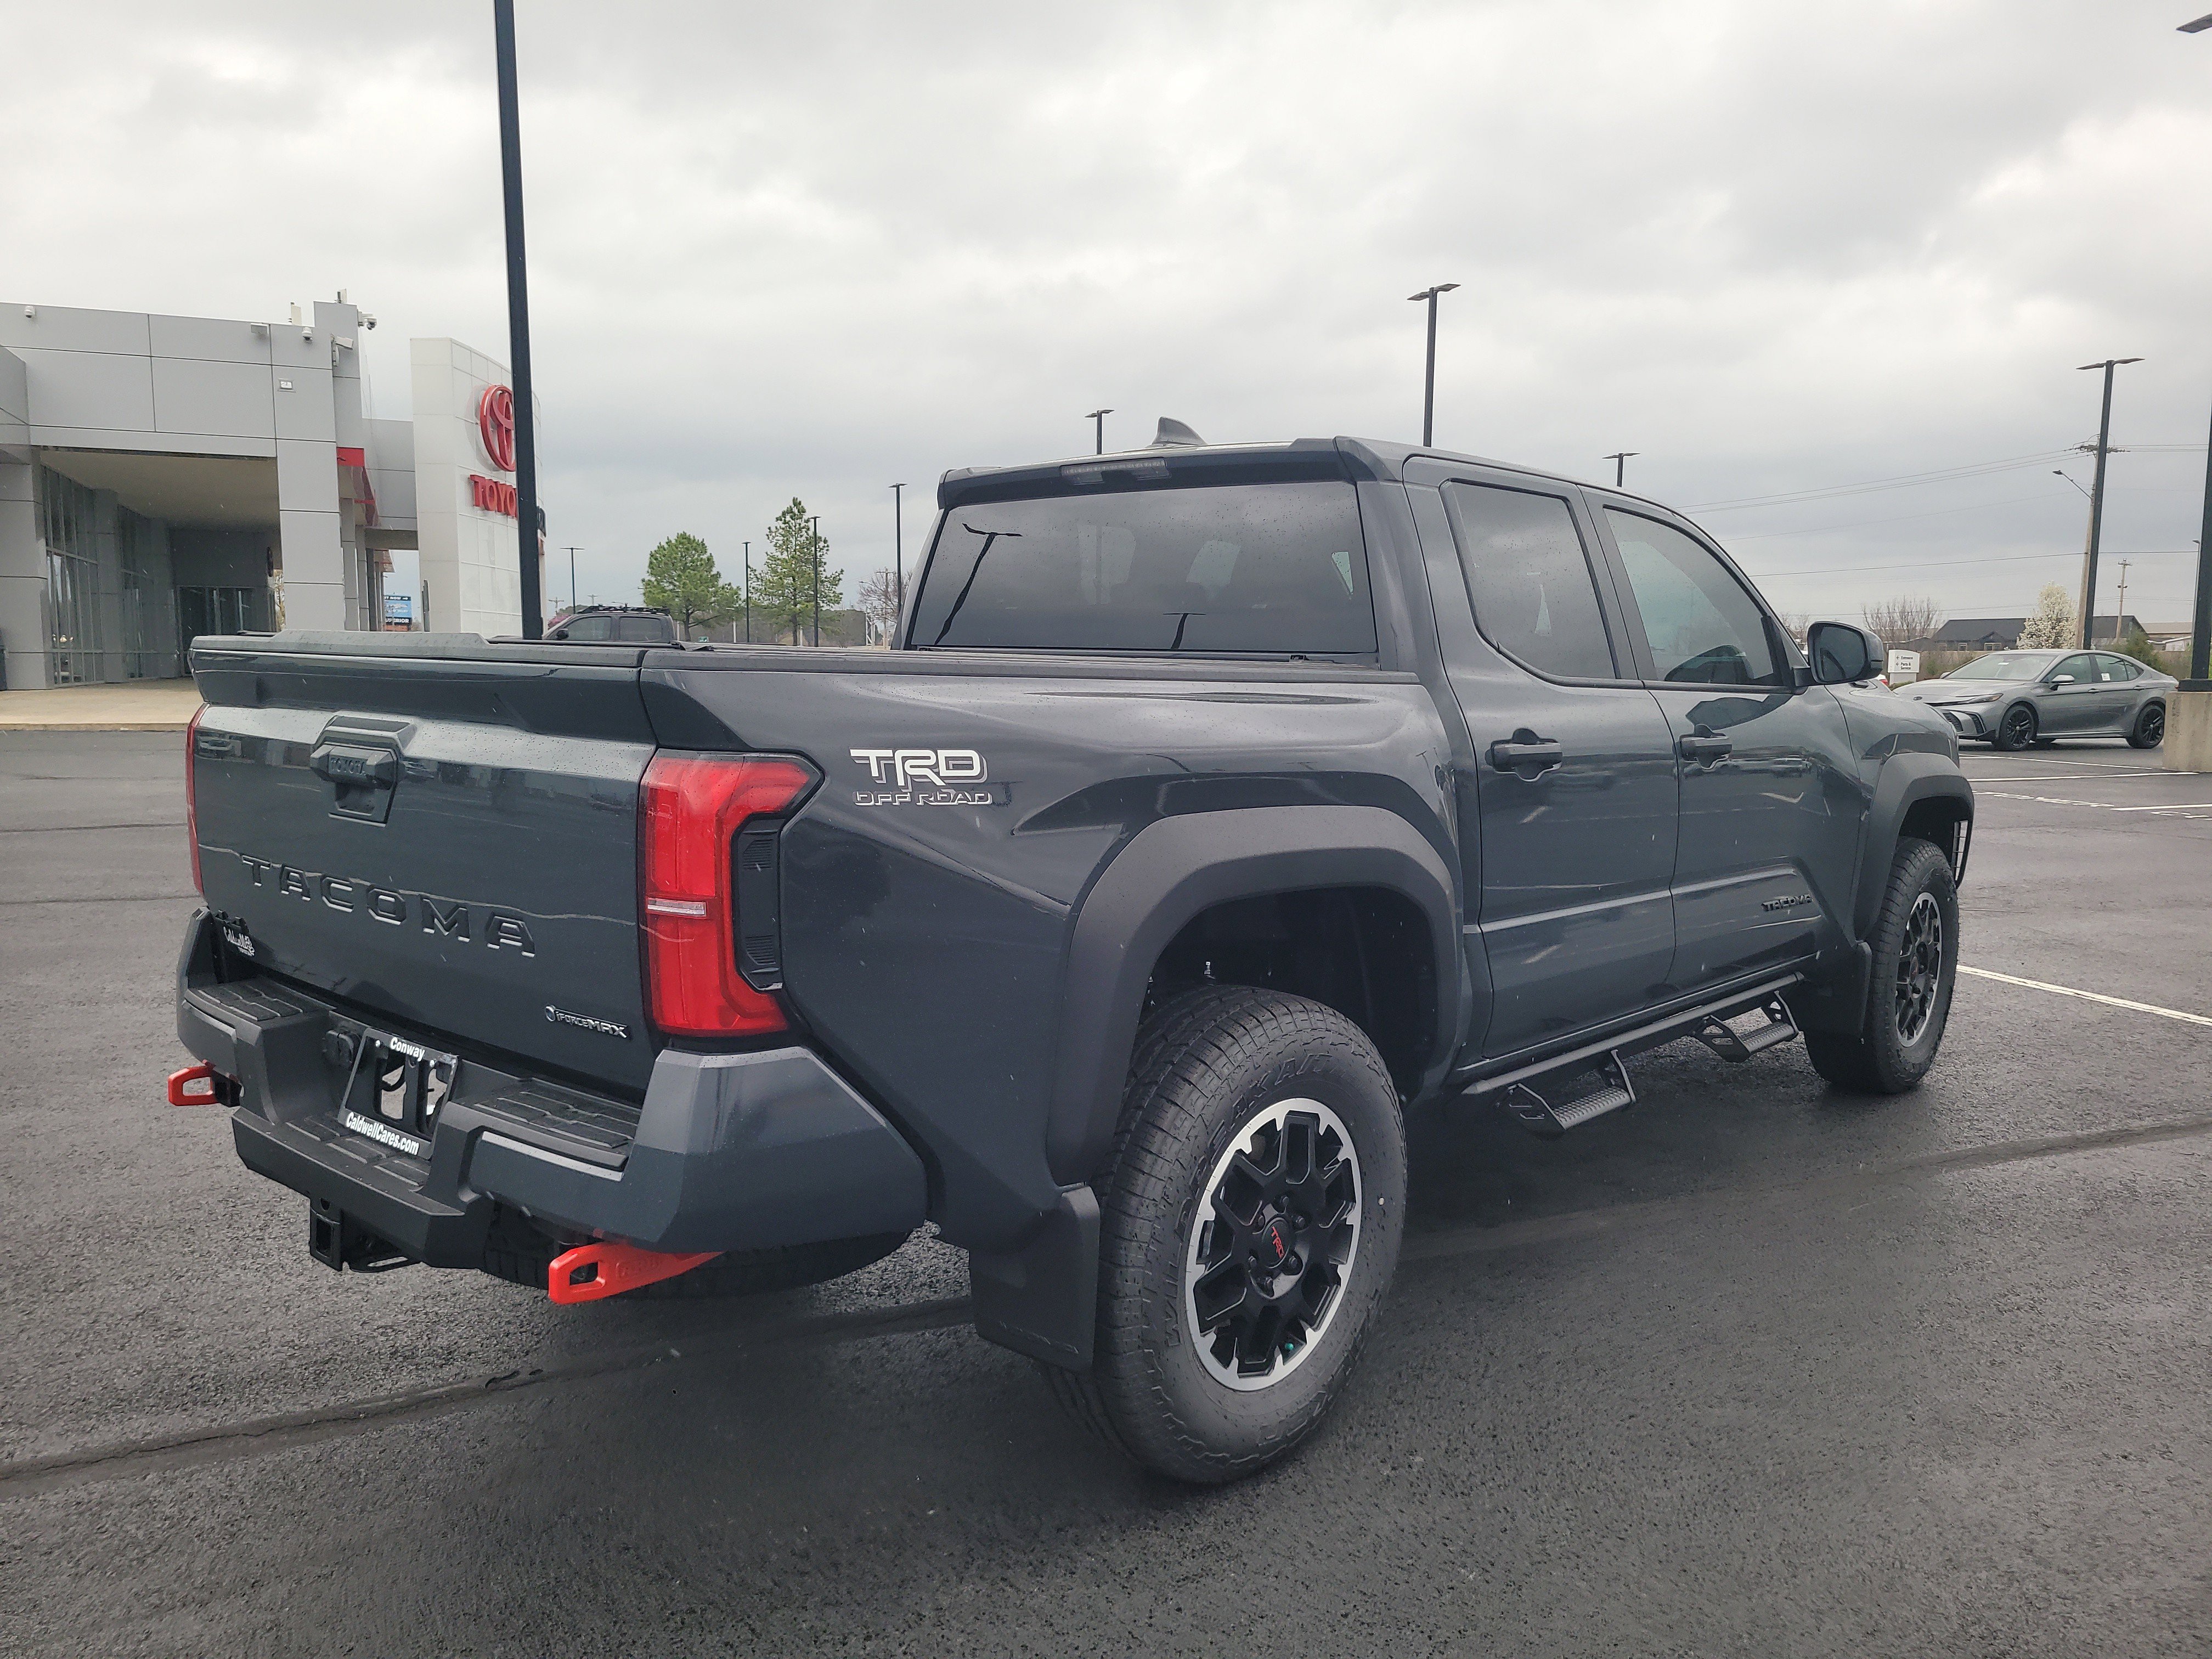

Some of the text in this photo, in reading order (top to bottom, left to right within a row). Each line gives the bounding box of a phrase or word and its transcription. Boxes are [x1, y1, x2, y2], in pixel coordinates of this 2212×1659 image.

[850, 749, 985, 788] TRD
[853, 791, 992, 805] OFF ROAD
[241, 854, 535, 957] TACOMA
[1760, 894, 1814, 912] TACOMA
[390, 1036, 426, 1062] Conway
[346, 1111, 420, 1156] CaldwellCares.com
[1271, 1226, 1285, 1259] TRD
